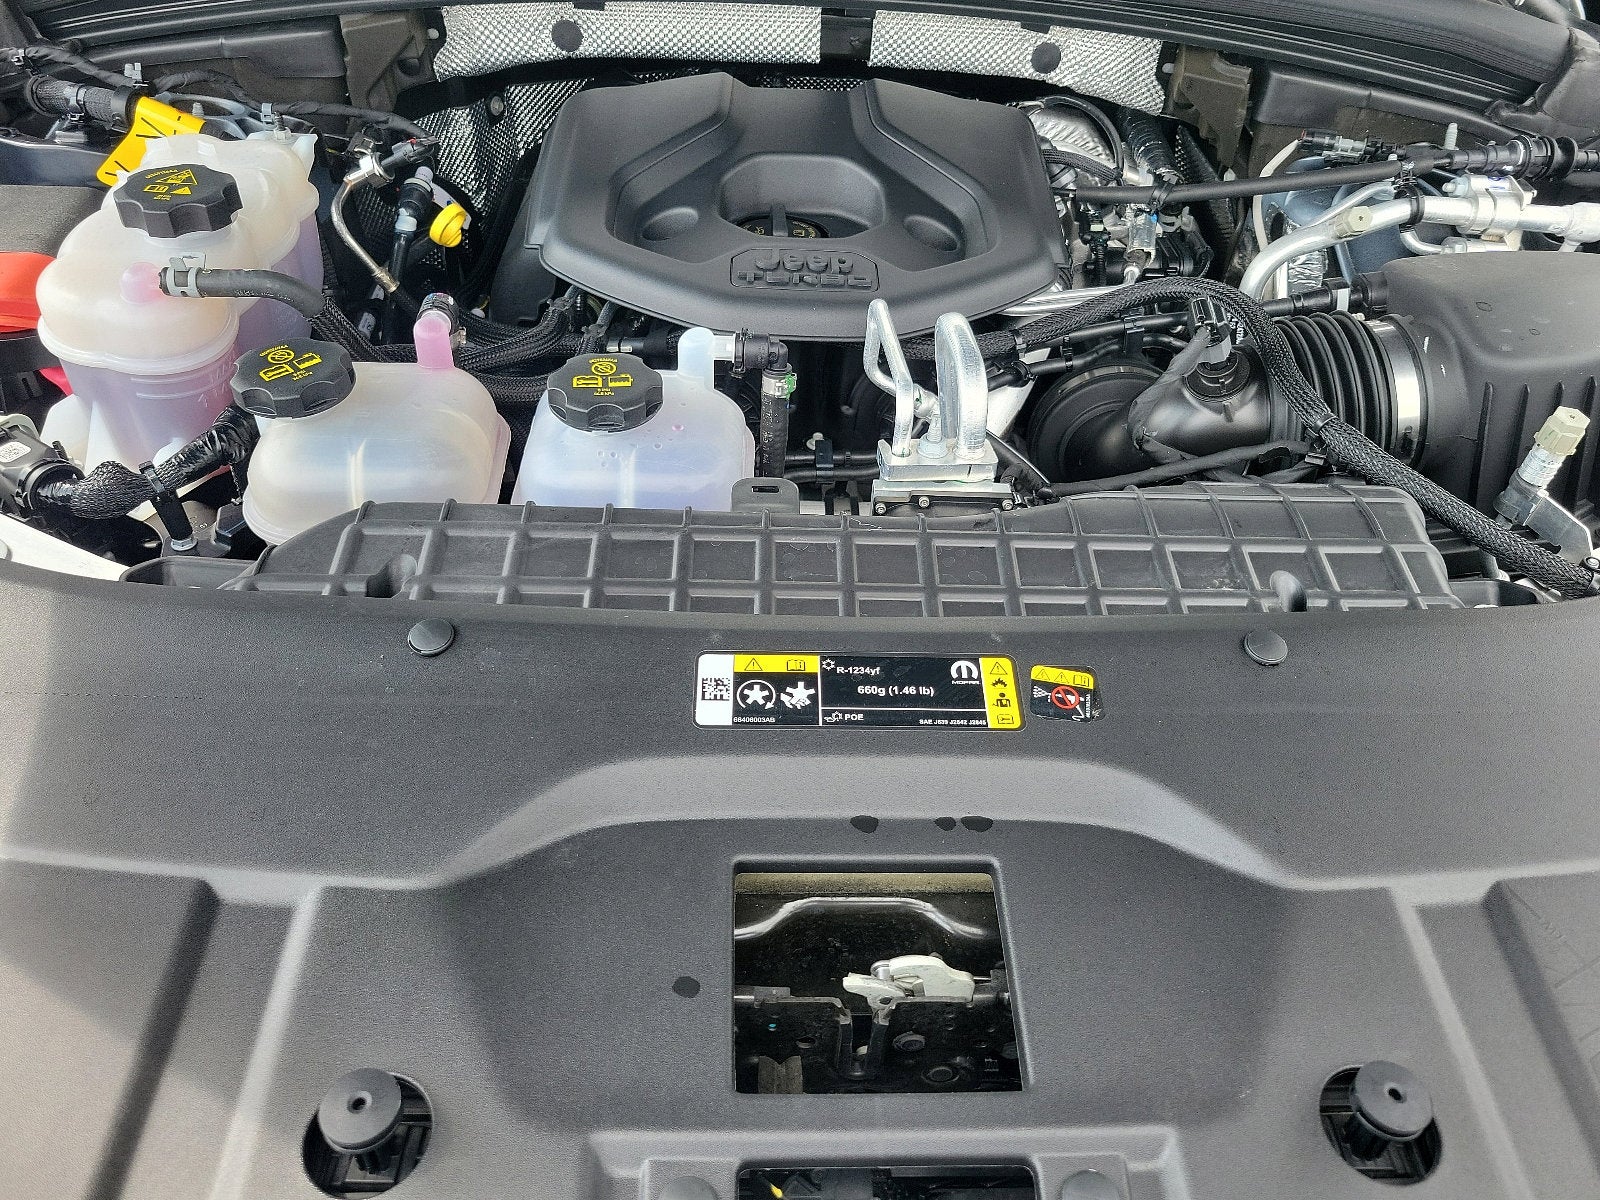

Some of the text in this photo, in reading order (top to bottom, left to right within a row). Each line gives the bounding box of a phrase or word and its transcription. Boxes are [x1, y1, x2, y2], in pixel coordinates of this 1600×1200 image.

[755, 249, 853, 275] Jeep
[836, 666, 880, 676] R-1234yf
[857, 685, 935, 698] 660g (1.46 lb)
[844, 713, 864, 721] POE
